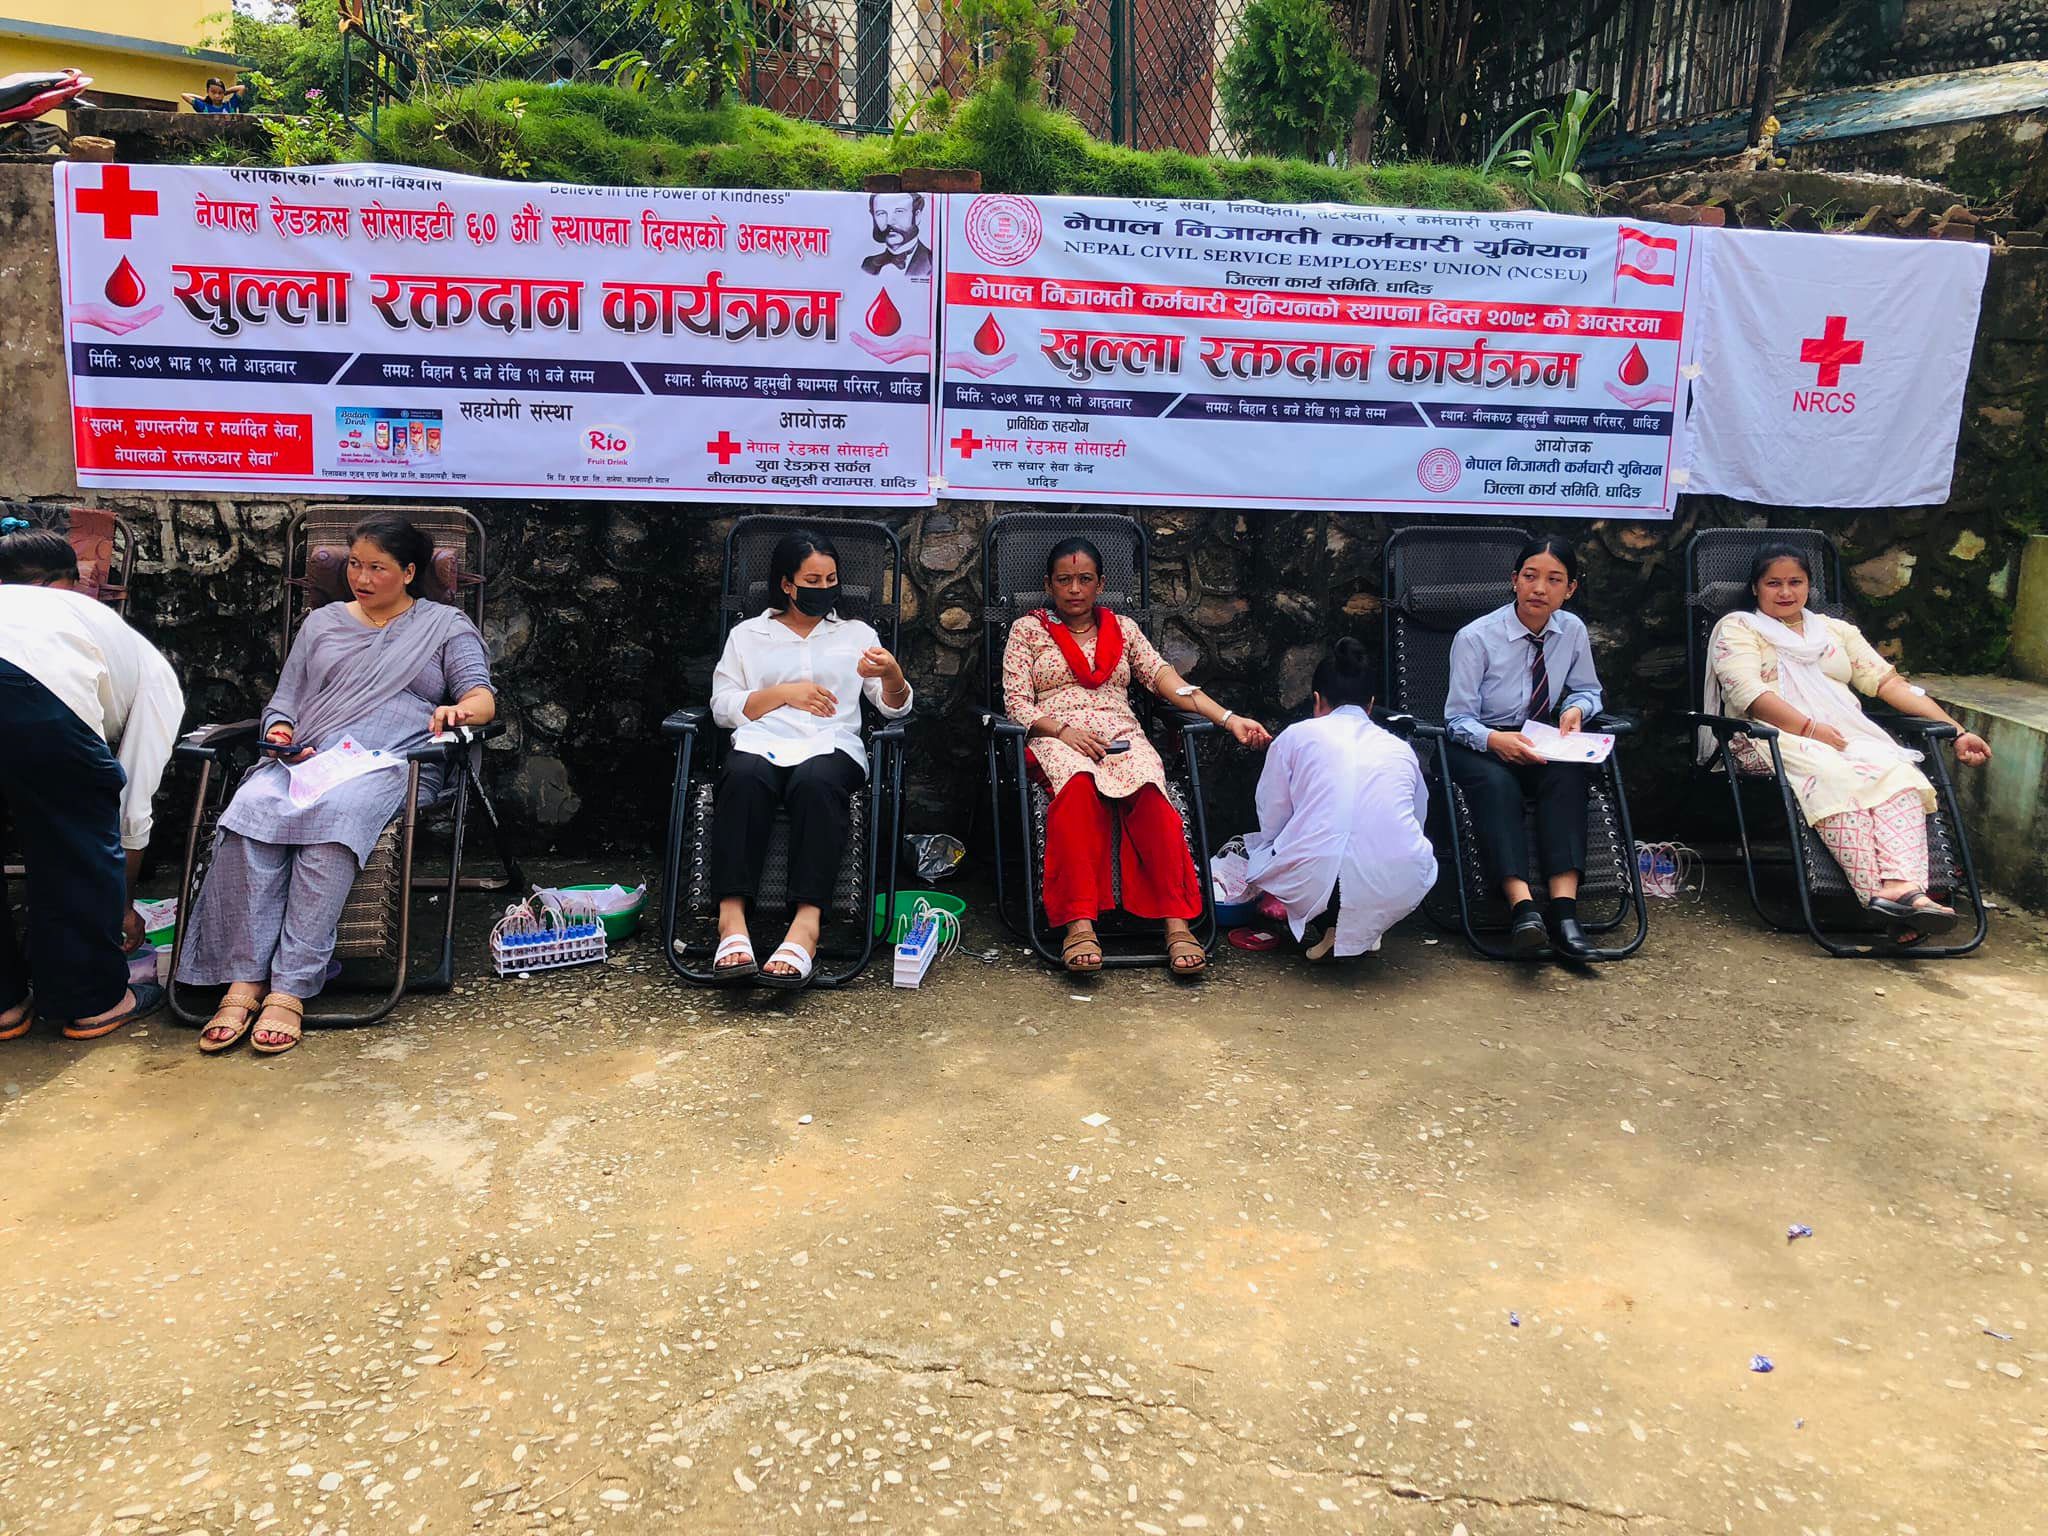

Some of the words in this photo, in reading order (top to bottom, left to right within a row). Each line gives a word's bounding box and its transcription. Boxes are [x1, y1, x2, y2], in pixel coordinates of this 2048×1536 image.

[625, 187, 648, 198] the
[653, 188, 697, 200] Power
[702, 190, 715, 201] of
[194, 192, 259, 233] नेपाल
[270, 197, 350, 237] रेडक्रस
[360, 201, 454, 242] सोसाइटी
[466, 212, 496, 245] ६०
[551, 216, 631, 247] स्थापना
[641, 209, 727, 253] दिवसको
[737, 223, 831, 259] अवसरमा
[1489, 218, 1533, 232] एकता
[1064, 212, 1163, 236] नेपाल
[1175, 219, 1322, 244] निजामती
[1332, 232, 1463, 253] कर्मचारी
[1474, 239, 1591, 260] युनियन
[1064, 241, 1135, 257] NEPAL
[1140, 245, 1199, 261] CIVIL
[1204, 248, 1292, 265] SERVICE
[1299, 254, 1428, 273] EMPLOYEES'
[1434, 262, 1501, 278] UNION
[1508, 266, 1587, 284] (NCSEU)
[1226, 271, 1280, 287] जिल्ला
[1285, 276, 1322, 289] कार्य
[171, 264, 351, 336] खुल्ला
[370, 273, 585, 336] रक्तदान
[601, 271, 844, 344] कार्यक्रम
[970, 277, 1033, 302] नेपाल
[1041, 282, 1136, 307] निजामती
[1142, 287, 1226, 312] कर्मचारी
[1233, 293, 1340, 320] युनियनको
[1349, 302, 1421, 323] स्थापना
[1428, 303, 1481, 326] दिवस
[1486, 309, 1535, 327] २०७९
[1543, 307, 1569, 329] को
[1576, 316, 1662, 334] अवसरमा
[129, 355, 162, 372] २०७९
[168, 356, 192, 372] भाद्र
[198, 357, 212, 373] १९
[219, 355, 237, 373] गते
[1040, 328, 1186, 383] खुल्ला
[1200, 335, 1376, 384] रक्तदान
[1387, 338, 1582, 390] कार्यक्रम
[460, 366, 467, 382] ६
[498, 363, 522, 382] देखि
[527, 368, 539, 383] ११
[570, 370, 595, 384] सम्म
[701, 372, 749, 390] नीलकण्ठ
[753, 374, 791, 395] बहुमुखी
[797, 378, 838, 393] क्याम्पस
[843, 376, 882, 397] परिसर,
[460, 398, 521, 422] सहयोगी
[530, 400, 574, 422] संस्था
[990, 392, 1018, 406] २०७९
[1024, 393, 1044, 407] भाद्र
[1049, 394, 1061, 408] १९
[1067, 393, 1082, 408] गते
[1793, 391, 1856, 413] NRCS
[780, 408, 848, 430] आयोजक
[1272, 404, 1278, 416] ६
[1304, 402, 1325, 417] देखि
[1329, 406, 1340, 419] ११
[1365, 408, 1387, 420] सम्म
[1472, 410, 1512, 424] नीलकण्ठ
[1554, 414, 1588, 427] क्याम्पस
[135, 417, 198, 438] गुणस्तरीय
[205, 422, 215, 438] र
[220, 418, 267, 439] मर्यादित
[1007, 415, 1048, 431] प्राविधिक
[1052, 419, 1090, 433] सहयोग
[588, 431, 627, 451] Rio
[747, 439, 780, 455] नेपाल
[788, 440, 830, 457] रेडक्रस
[837, 441, 889, 458] सोसाइटी
[985, 435, 1018, 453] नेपाल
[1025, 436, 1068, 455] रेडक्रस
[1074, 438, 1127, 458] सोसाइटी
[1535, 437, 1593, 453] आयोजक
[114, 445, 166, 465] नेपालको
[756, 459, 779, 474] युवा
[784, 458, 829, 473] रेडक्रस
[834, 460, 871, 474] सर्कल
[992, 460, 1012, 470] रक्त
[1050, 460, 1069, 472] सेवा
[1073, 460, 1095, 474] केन्द्र
[1465, 455, 1501, 471] नेपाल
[1506, 457, 1560, 473] निजामती
[1564, 459, 1613, 476] कर्मचारी
[1617, 460, 1663, 478] युनियन
[707, 471, 767, 485] नीलकण्ठ
[771, 474, 817, 488] बहुमुखी
[1484, 479, 1524, 495] जिल्ला
[1528, 482, 1556, 496] कार्य
